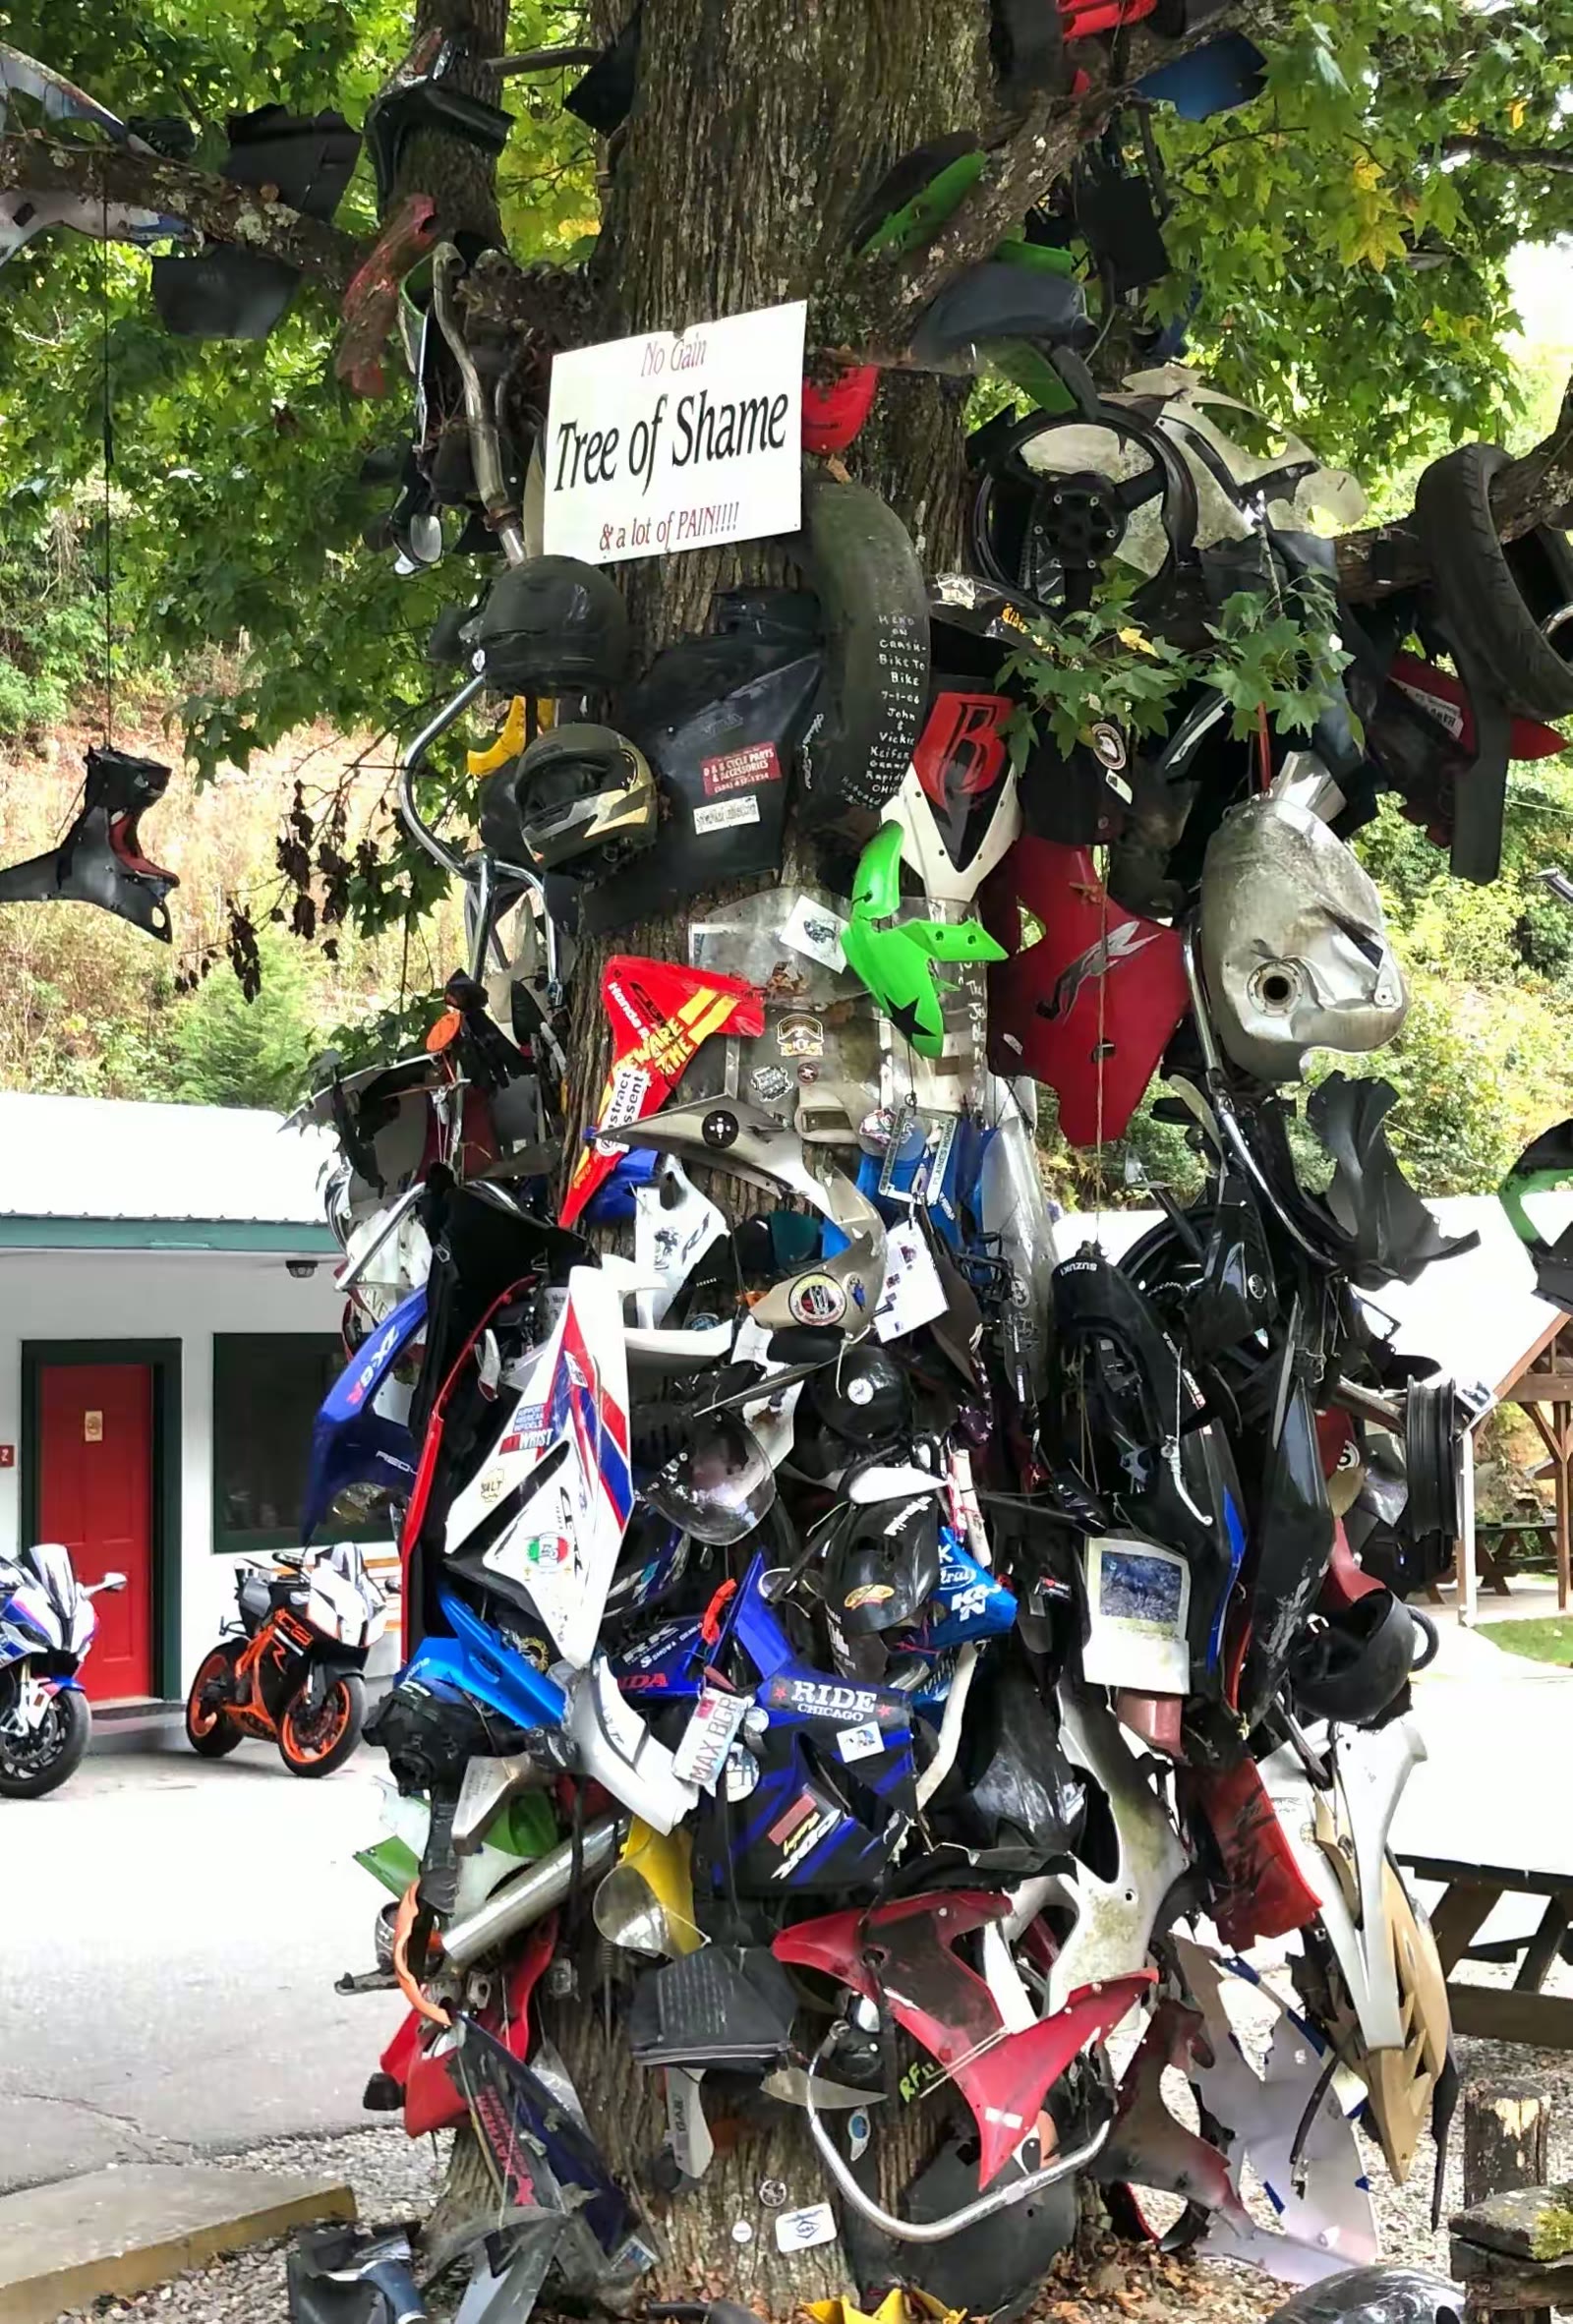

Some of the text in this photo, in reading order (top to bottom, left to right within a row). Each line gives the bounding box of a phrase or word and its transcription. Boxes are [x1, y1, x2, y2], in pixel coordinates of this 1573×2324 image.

[641, 332, 708, 378] No Gain
[553, 388, 788, 496] Tree of Shame
[599, 500, 740, 552] & a lot of PAIN!!!!
[749, 747, 775, 763] PARTS
[608, 982, 642, 1030] Honda
[942, 1118, 956, 1148] HONDA
[1060, 1261, 1098, 1277] SUZUKI
[790, 1679, 878, 1714] RIDE
[797, 1703, 865, 1722] CHICAGO
[690, 1739, 722, 1783] MAX
